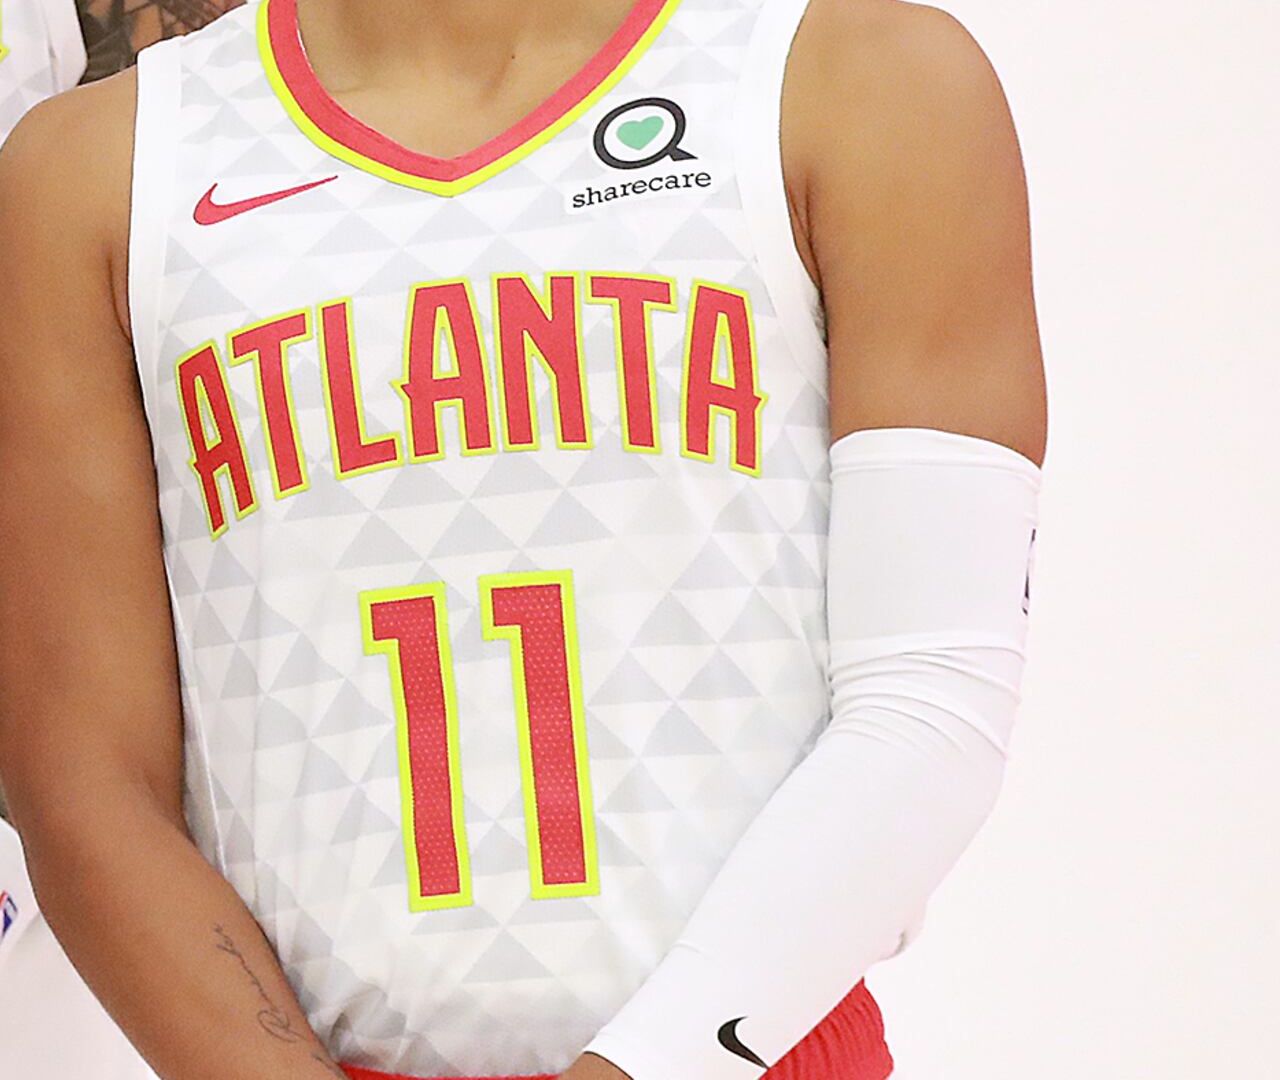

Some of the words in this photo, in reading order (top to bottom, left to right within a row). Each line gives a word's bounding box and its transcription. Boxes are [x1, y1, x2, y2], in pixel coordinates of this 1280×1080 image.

[572, 171, 712, 209] sharecare
[175, 269, 770, 541] ATLANTA
[358, 568, 601, 914] 11
